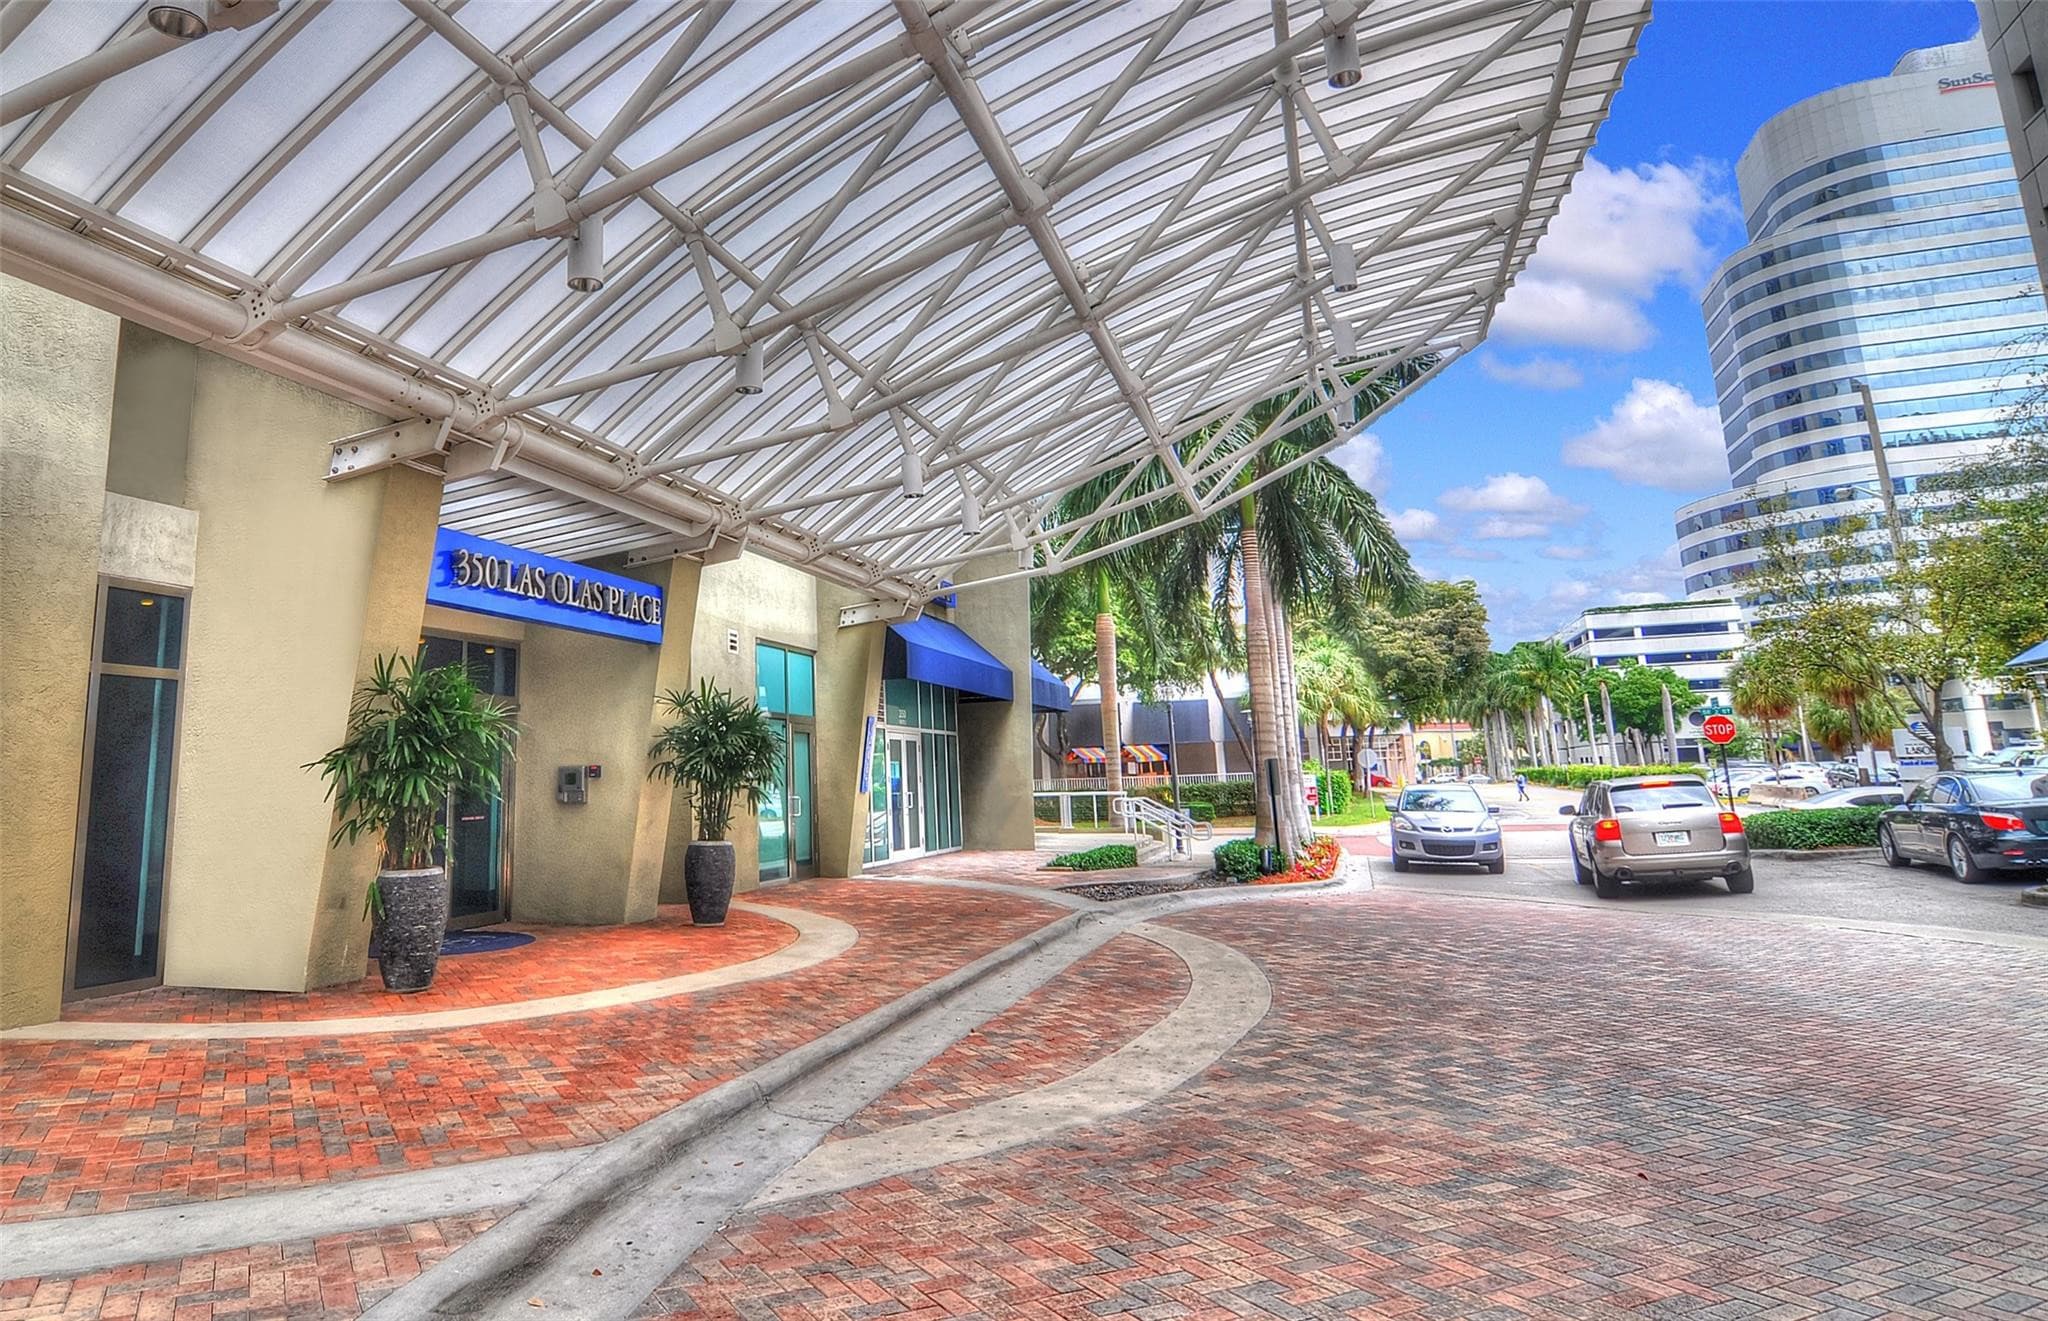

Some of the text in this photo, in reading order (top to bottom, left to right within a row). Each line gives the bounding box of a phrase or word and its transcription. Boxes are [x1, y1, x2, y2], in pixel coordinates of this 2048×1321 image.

[456, 548, 662, 625] 350 LAS OLAS PLACE
[1705, 723, 1733, 735] STOP
